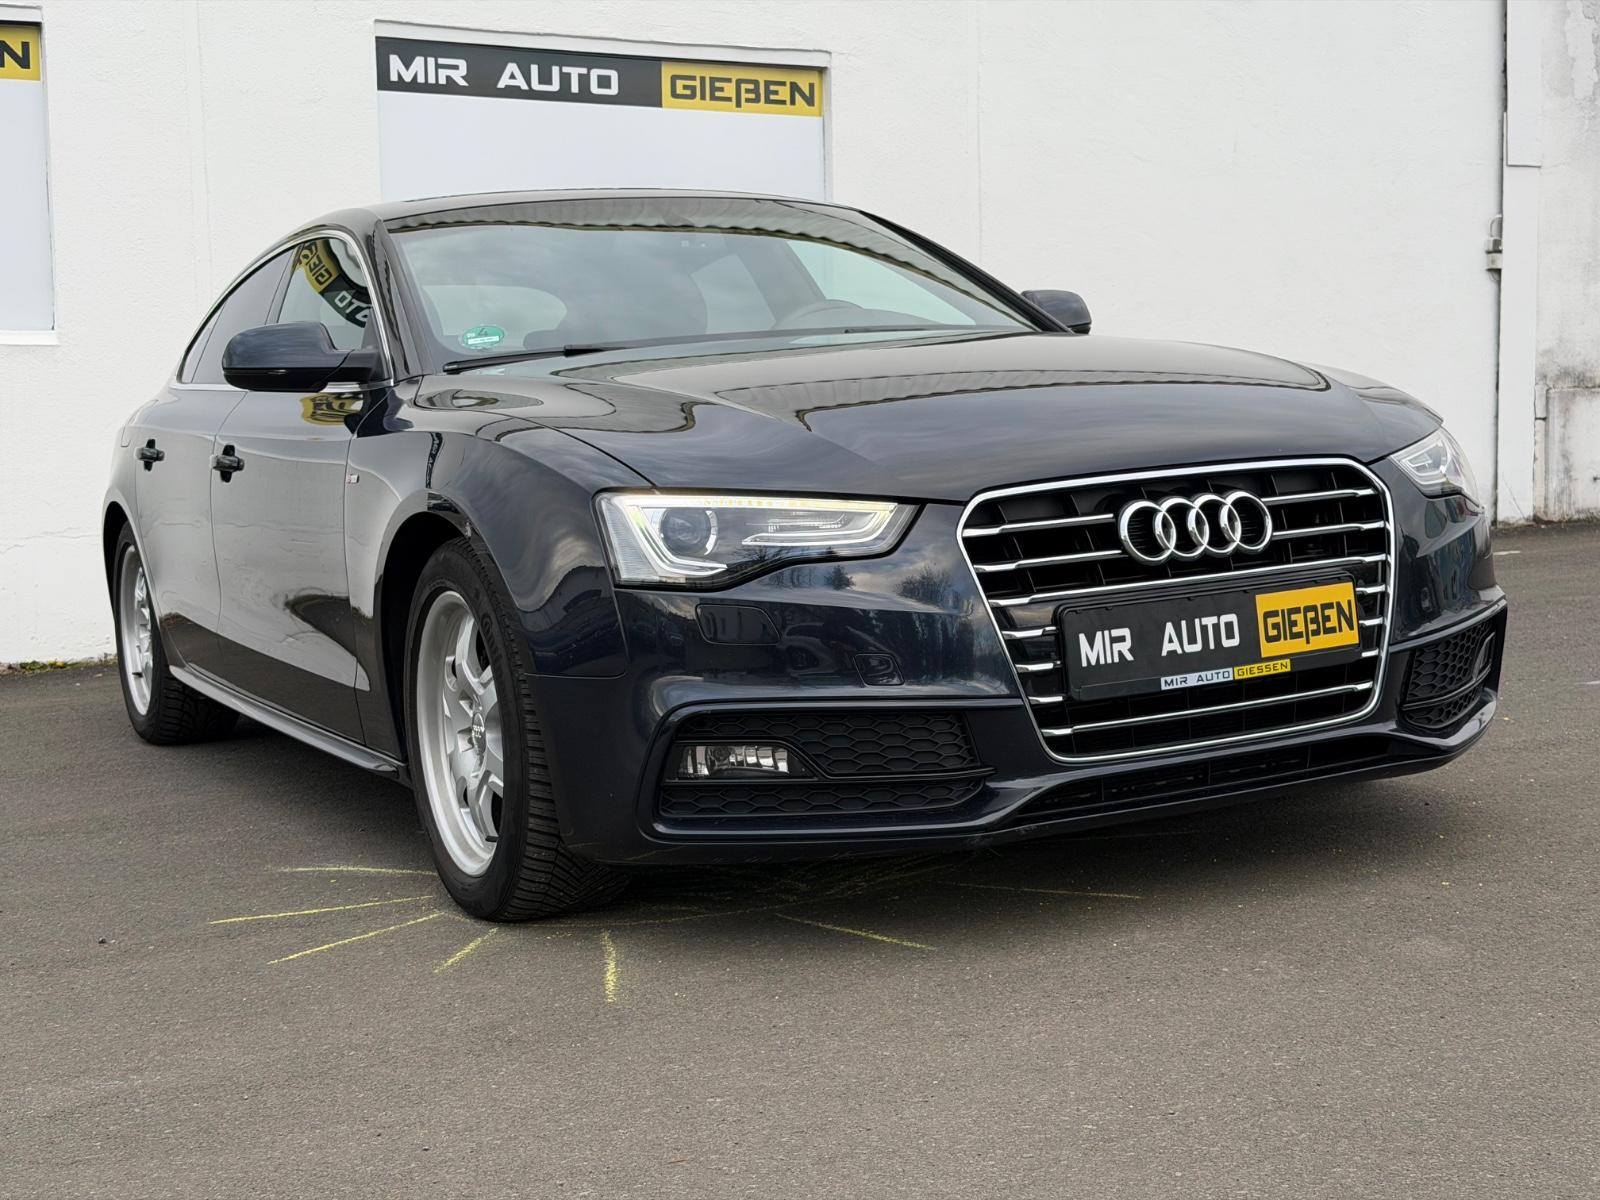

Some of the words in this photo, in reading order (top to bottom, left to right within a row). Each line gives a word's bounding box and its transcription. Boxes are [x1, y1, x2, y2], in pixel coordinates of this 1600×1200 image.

[389, 54, 470, 86] MIR
[496, 62, 619, 96] AUTO
[669, 74, 816, 109] GIEßEN
[1078, 627, 1134, 668] MIR
[1161, 613, 1240, 657] AUTO
[1262, 599, 1355, 645] GIEßEN
[1163, 676, 1188, 688] MIR
[1195, 670, 1231, 683] AUTO
[1236, 661, 1289, 678] GIESSEN
